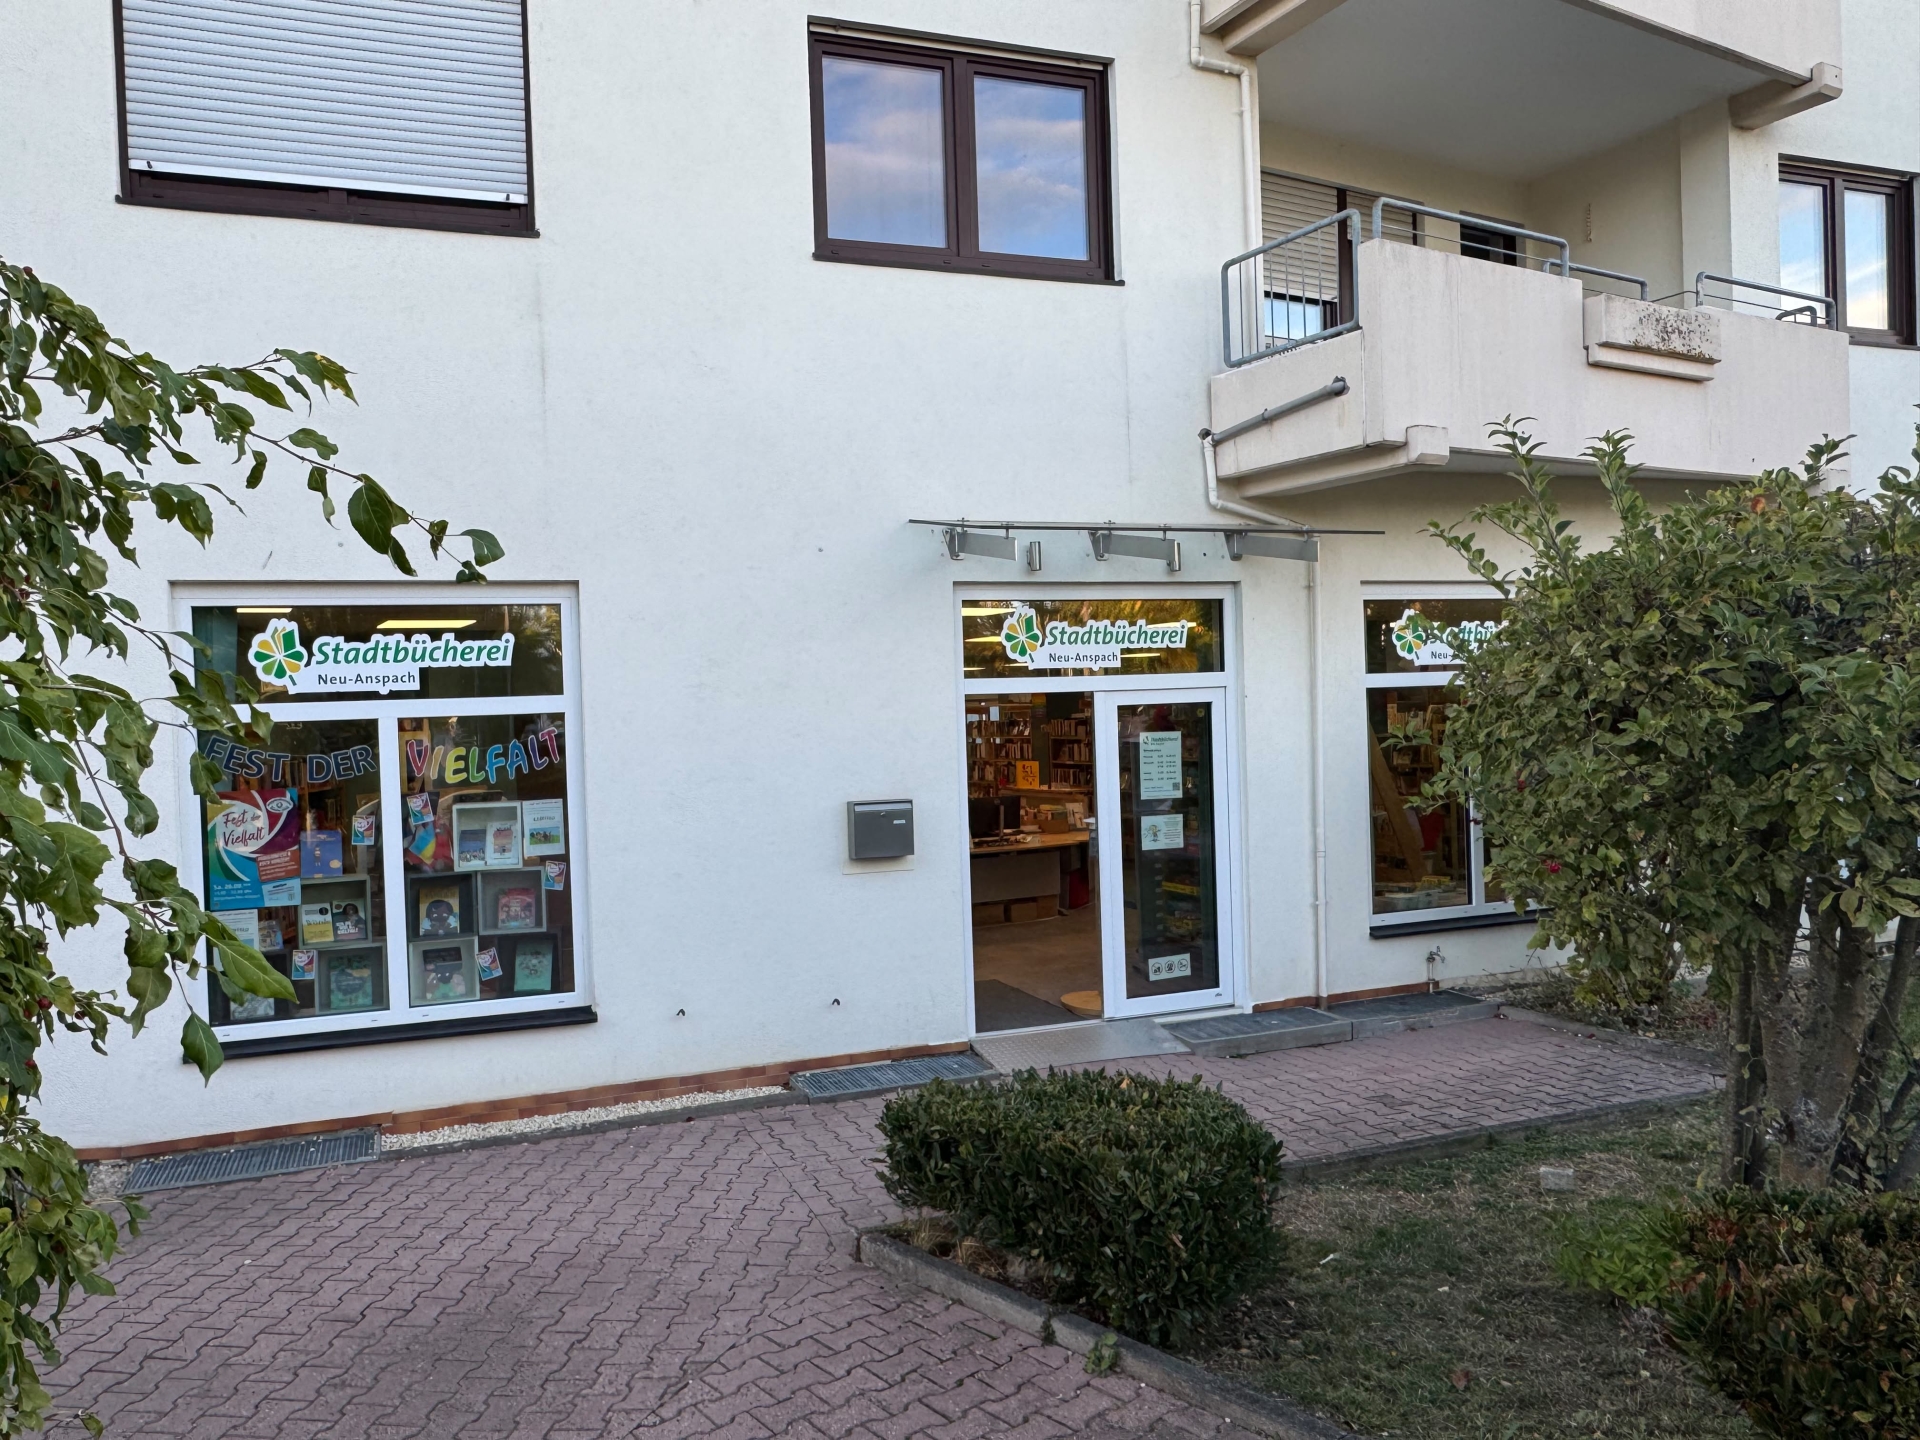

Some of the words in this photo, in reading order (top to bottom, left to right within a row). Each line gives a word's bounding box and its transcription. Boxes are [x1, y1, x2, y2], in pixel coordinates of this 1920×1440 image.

[1047, 624, 1186, 646] Stadtbücherei
[315, 638, 511, 666] Stadtbücherei
[1049, 652, 1119, 664] Neu-Anspach
[317, 671, 416, 688] Neu-Anspach
[204, 735, 291, 782] FEST
[306, 744, 377, 783] DER
[406, 727, 561, 784] VIELFALT
[222, 809, 249, 828] Fest
[223, 826, 265, 847] Vielfalt
